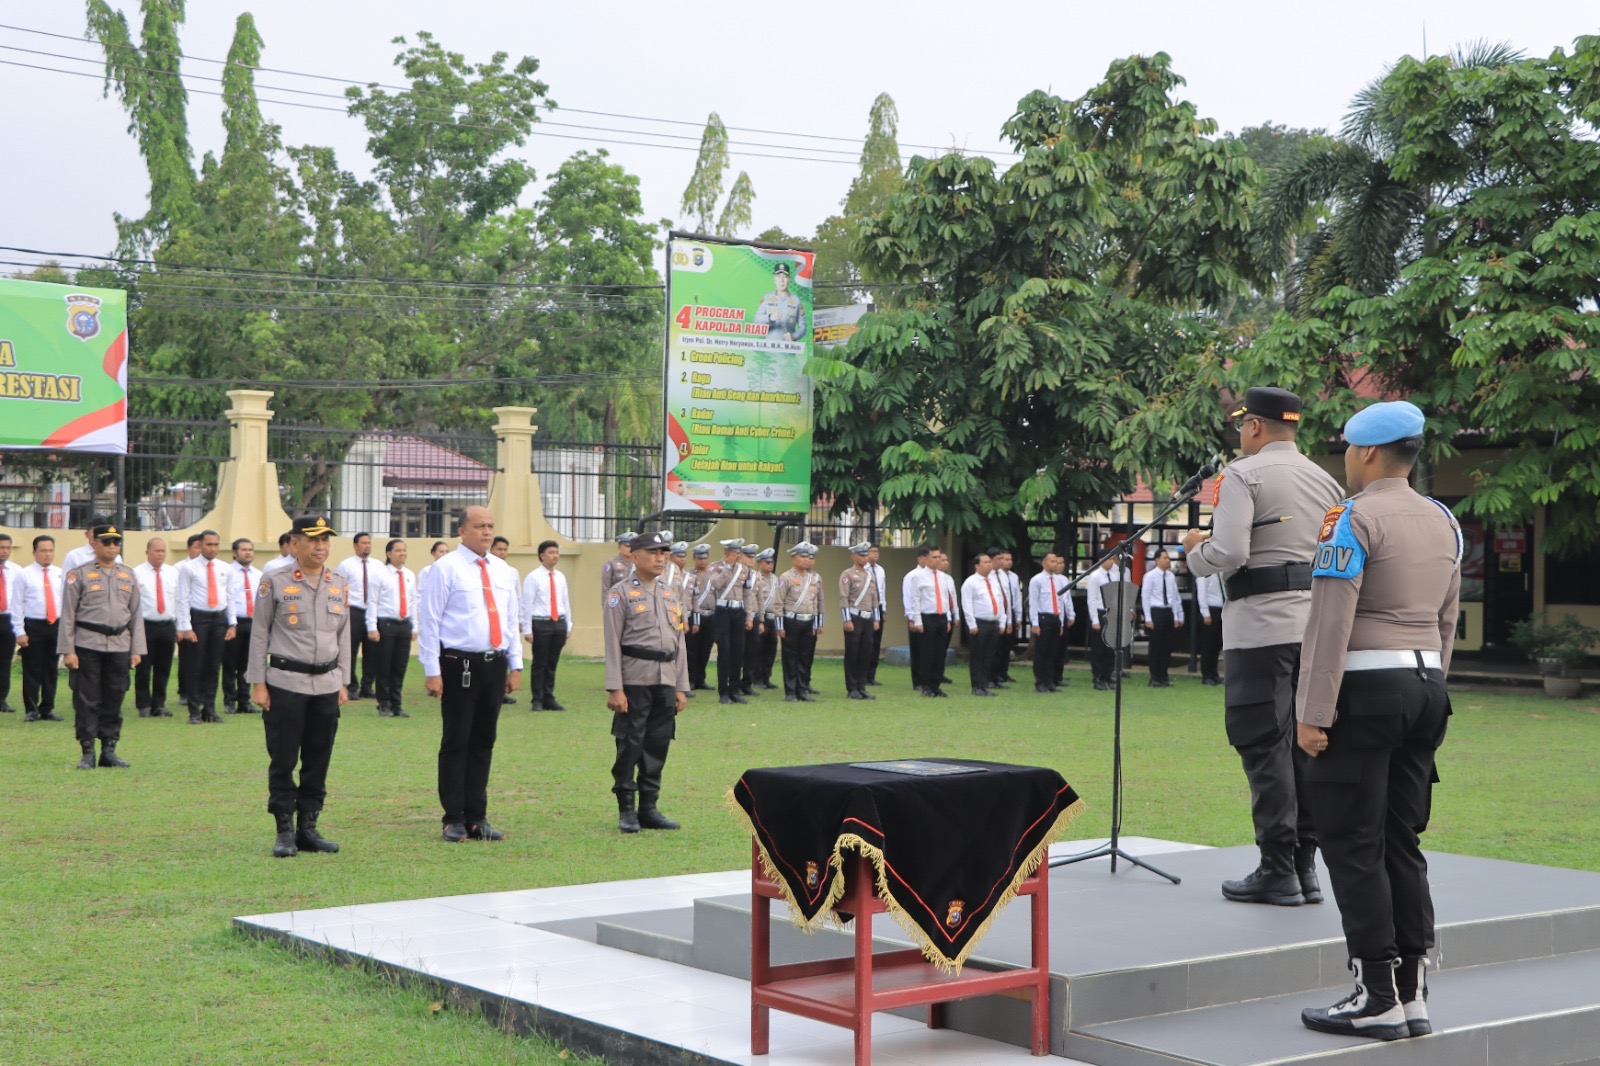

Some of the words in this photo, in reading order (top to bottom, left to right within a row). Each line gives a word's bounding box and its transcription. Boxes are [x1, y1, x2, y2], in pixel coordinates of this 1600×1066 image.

[676, 305, 692, 329] 4
[695, 306, 745, 320] PROGRAM
[695, 320, 742, 334] KAPOLDA
[744, 324, 769, 336] RIAU
[0, 341, 15, 367] A
[681, 351, 687, 361] 1.
[690, 350, 713, 363] Green
[681, 371, 688, 382] 2.
[691, 371, 711, 385] Raga
[681, 408, 688, 418] 3.
[690, 407, 714, 420] Radar
[750, 424, 770, 438] Cyber
[680, 443, 688, 455] 4.
[1310, 545, 1355, 573] OV
